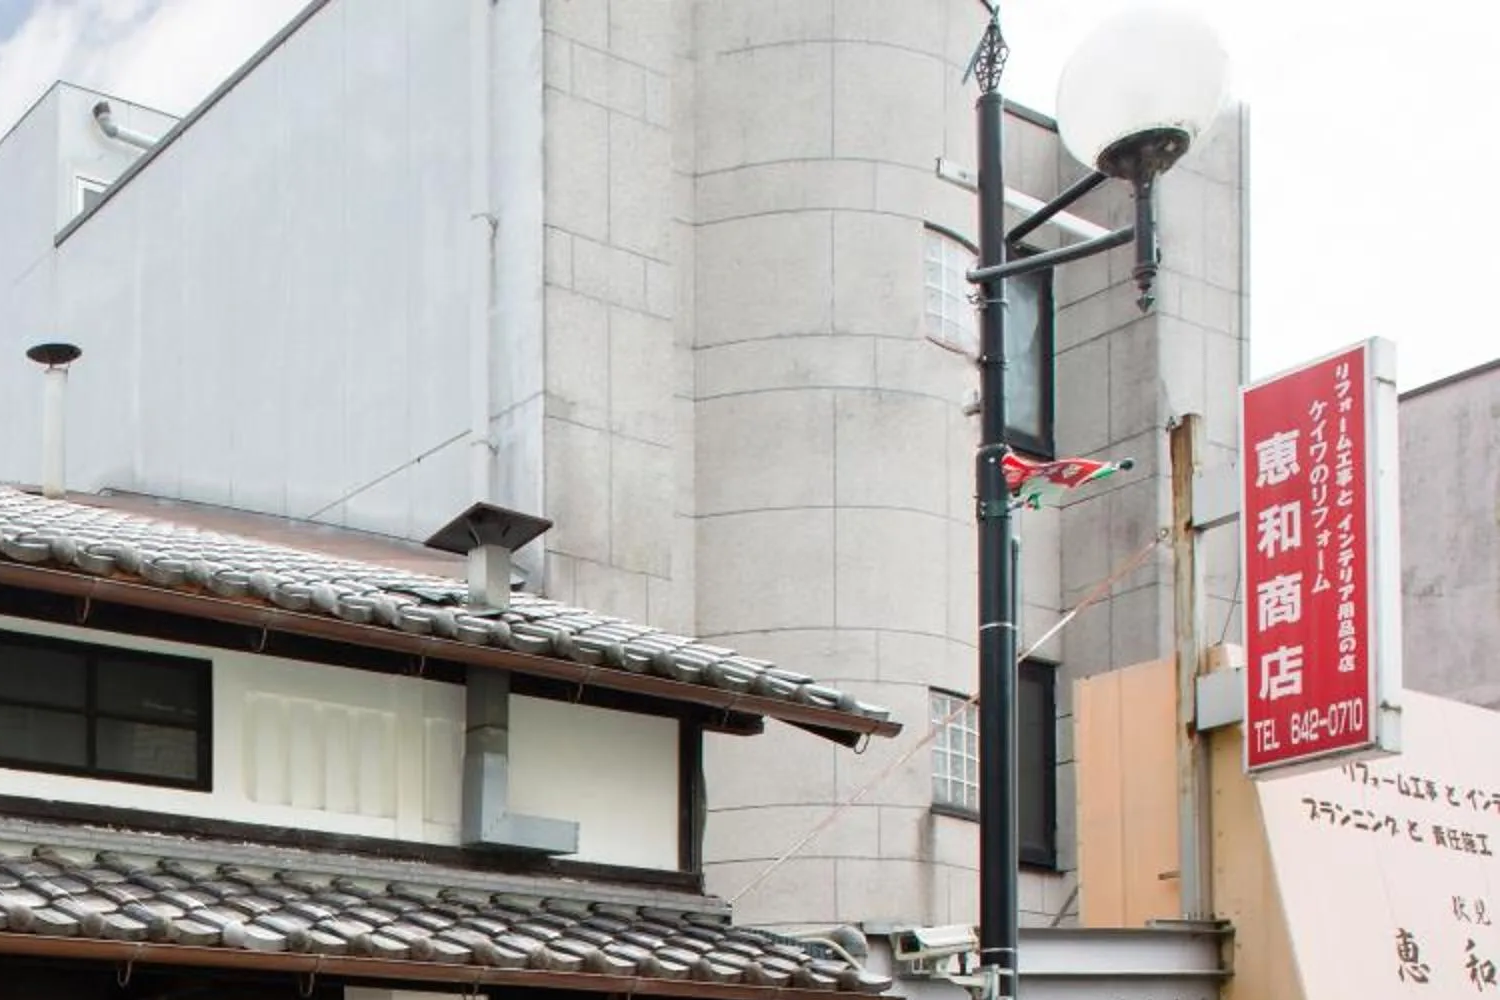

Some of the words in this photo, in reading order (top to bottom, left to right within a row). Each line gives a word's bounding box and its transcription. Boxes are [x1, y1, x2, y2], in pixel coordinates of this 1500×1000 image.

[1255, 429, 1304, 701] 恵和商店
[1308, 399, 1332, 594] ケイワのリフォーム
[1254, 719, 1281, 753] TEL
[1290, 697, 1363, 745] 642-0710
